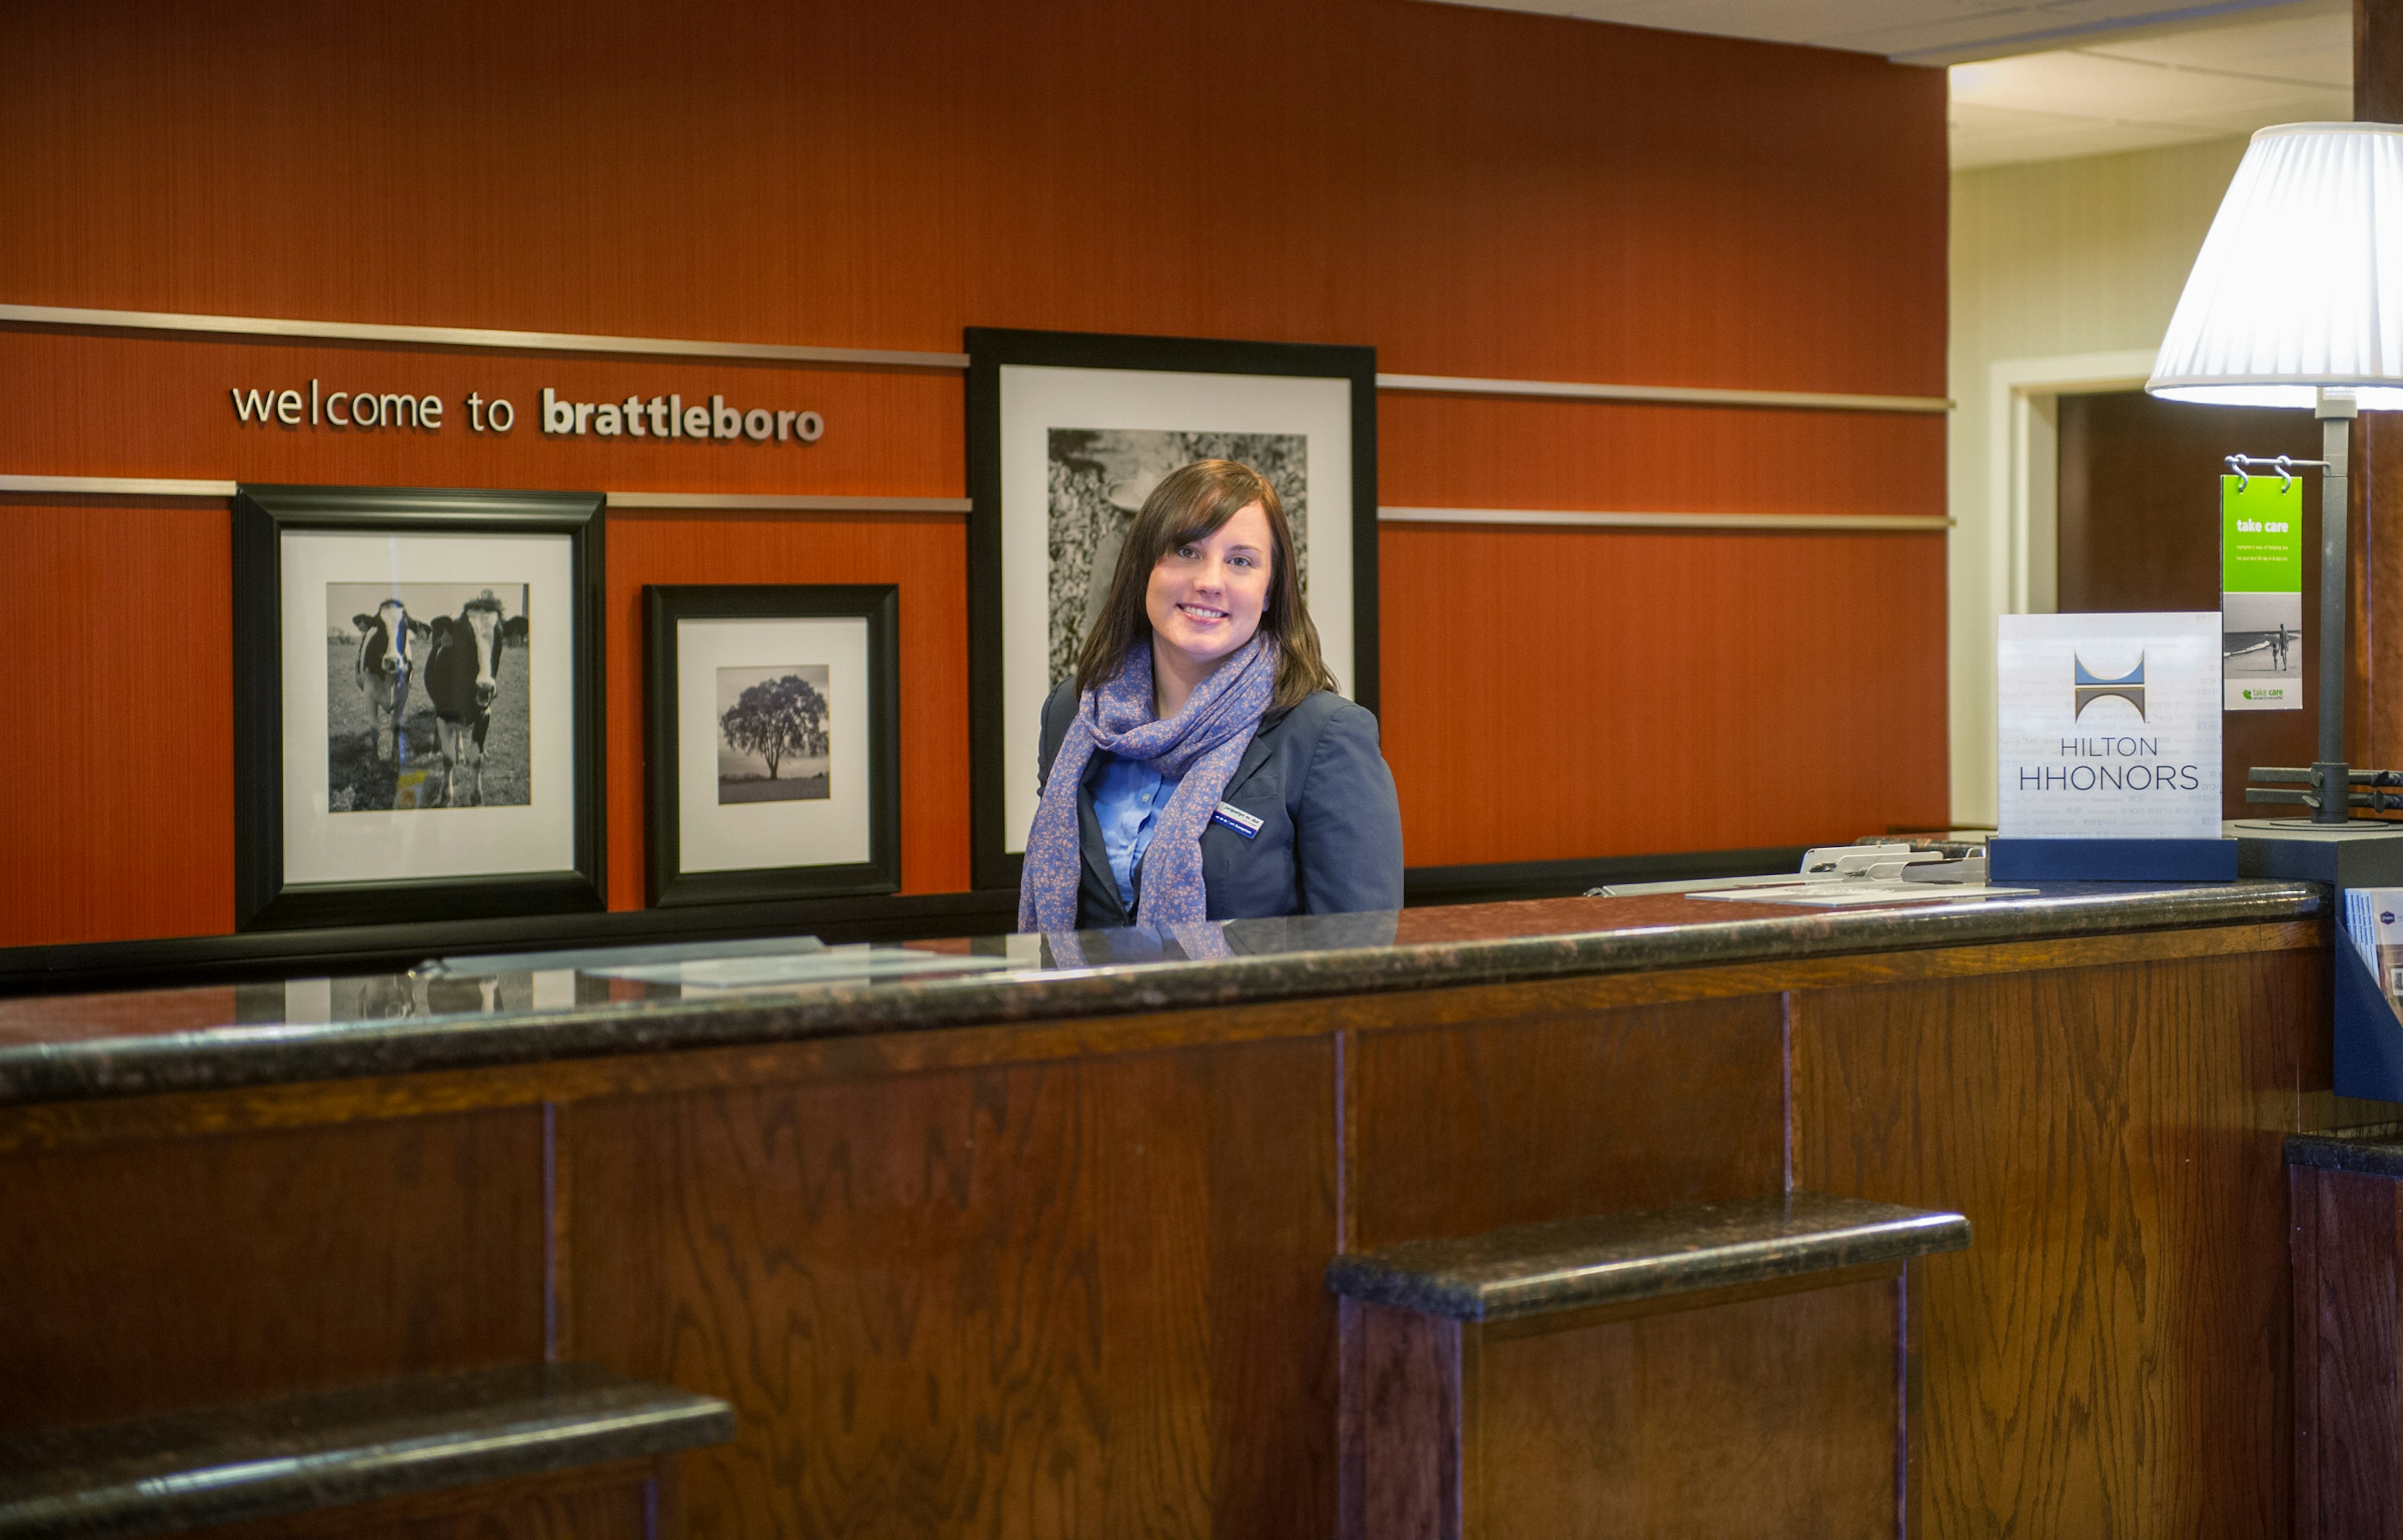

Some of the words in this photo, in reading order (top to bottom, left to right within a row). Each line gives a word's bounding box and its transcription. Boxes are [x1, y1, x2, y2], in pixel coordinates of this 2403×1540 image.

[231, 379, 443, 429] welcome
[467, 391, 515, 432] to
[541, 387, 824, 442] brattleboro
[2236, 518, 2262, 532] take
[2264, 522, 2288, 533] care
[2254, 688, 2267, 696] take
[2061, 737, 2157, 757] HILTON
[2020, 765, 2199, 791] HHONORS
